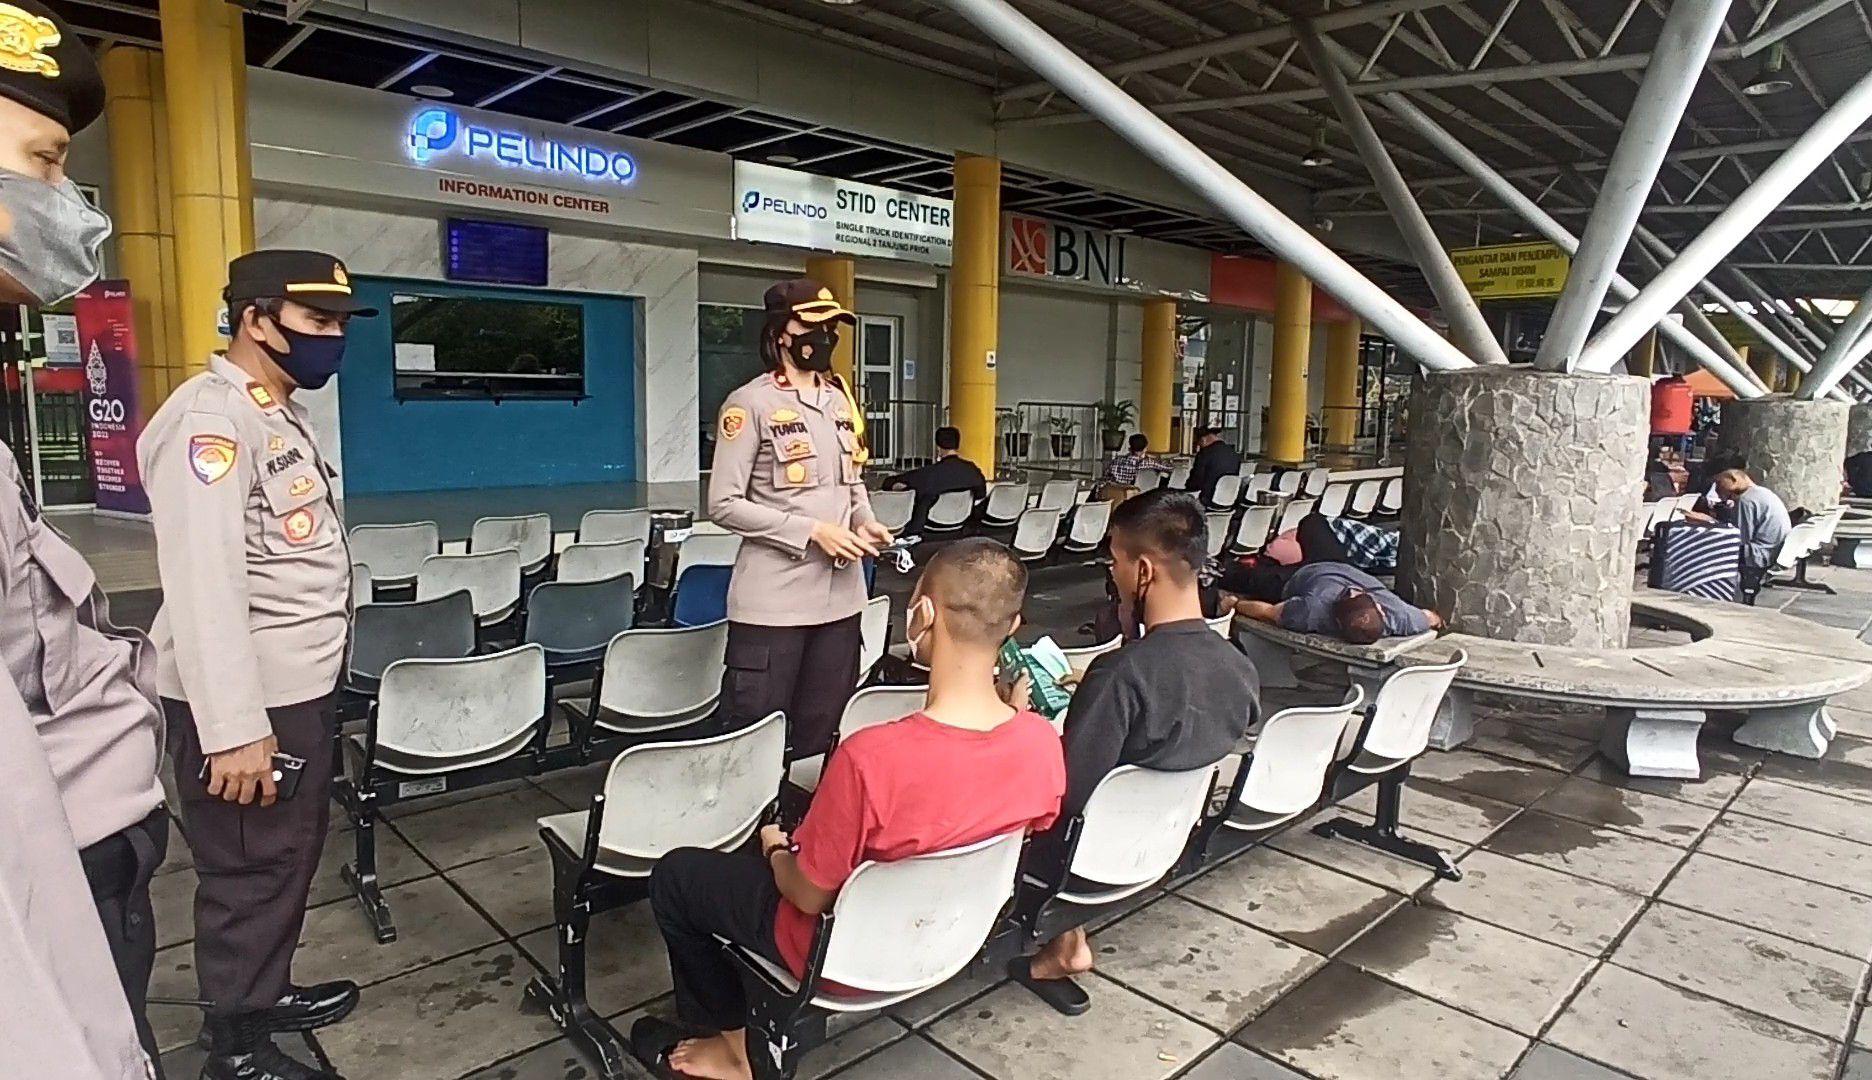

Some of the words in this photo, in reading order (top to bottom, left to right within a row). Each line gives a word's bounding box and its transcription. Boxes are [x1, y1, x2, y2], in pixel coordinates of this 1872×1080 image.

[465, 126, 635, 181] PELINDO
[439, 178, 548, 205] INFORMATION
[553, 194, 610, 214] CENTER
[763, 197, 827, 219] PELINDO
[836, 189, 876, 214] STID
[886, 198, 950, 227] CENTER
[835, 233, 871, 246] REGIONAL
[878, 239, 908, 252] TANJUNG
[836, 221, 864, 233] SINGLE
[866, 225, 890, 237] TRUCK
[891, 230, 946, 246] IDENTIFICATION
[1053, 224, 1126, 285] BNI
[1500, 251, 1517, 262] DAN
[89, 398, 125, 422] G20
